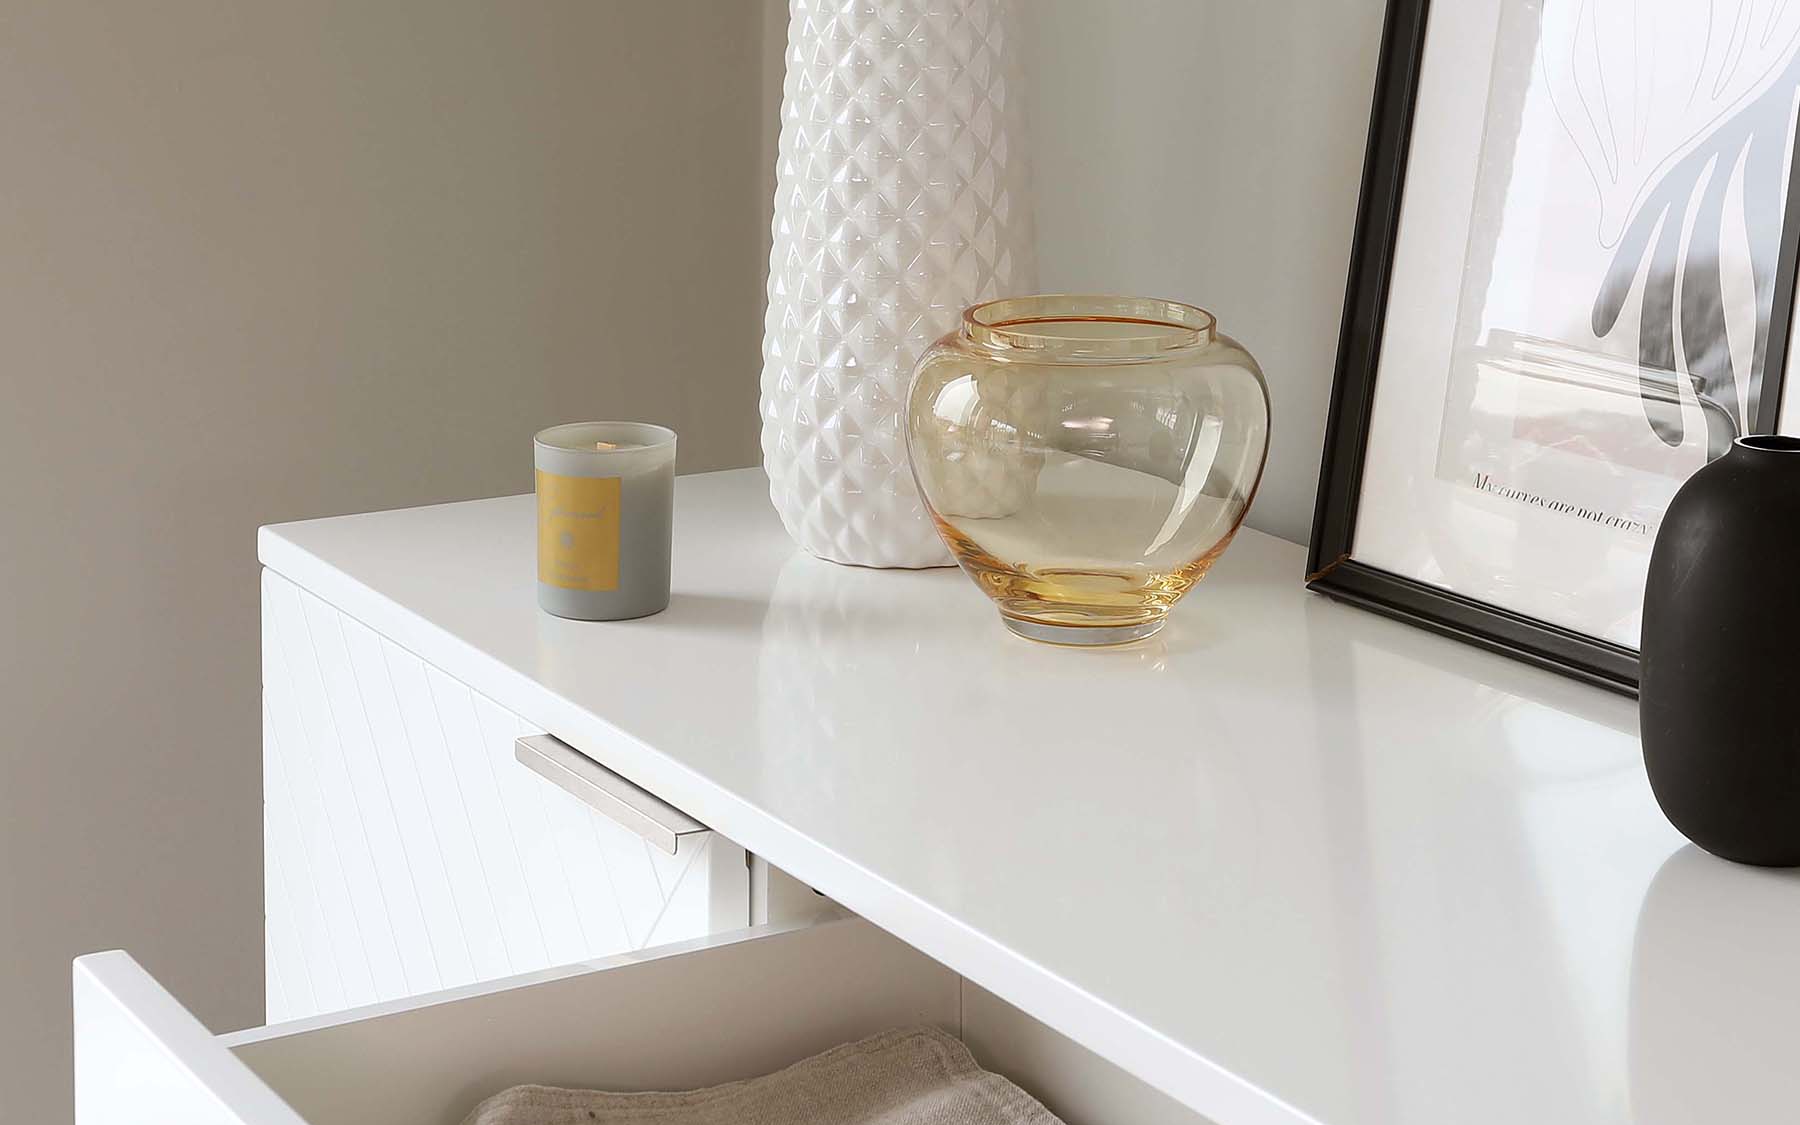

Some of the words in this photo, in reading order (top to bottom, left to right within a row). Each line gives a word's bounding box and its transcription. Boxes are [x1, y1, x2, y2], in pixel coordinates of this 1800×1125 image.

[1472, 472, 1497, 493] My
[1498, 486, 1545, 507] curves
[1548, 499, 1575, 514] are
[1577, 508, 1603, 523] not
[1605, 515, 1653, 536] crazy
